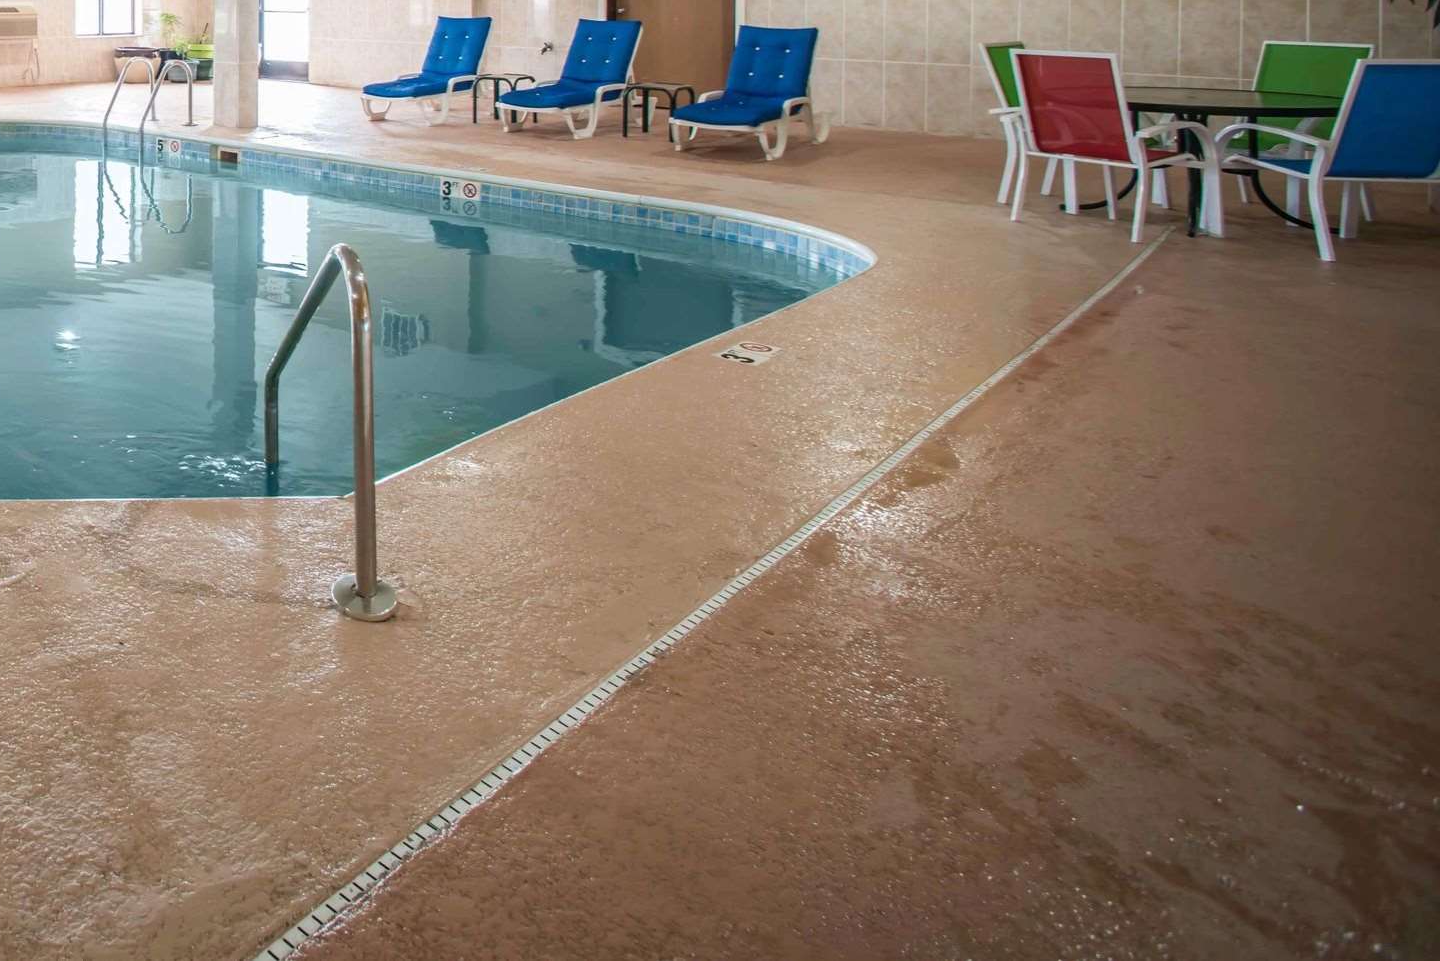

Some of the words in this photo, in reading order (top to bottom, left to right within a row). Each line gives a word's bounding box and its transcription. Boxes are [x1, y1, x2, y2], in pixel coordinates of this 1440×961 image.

[157, 139, 164, 152] 5
[442, 181, 451, 196] 3
[721, 353, 755, 363] 3
